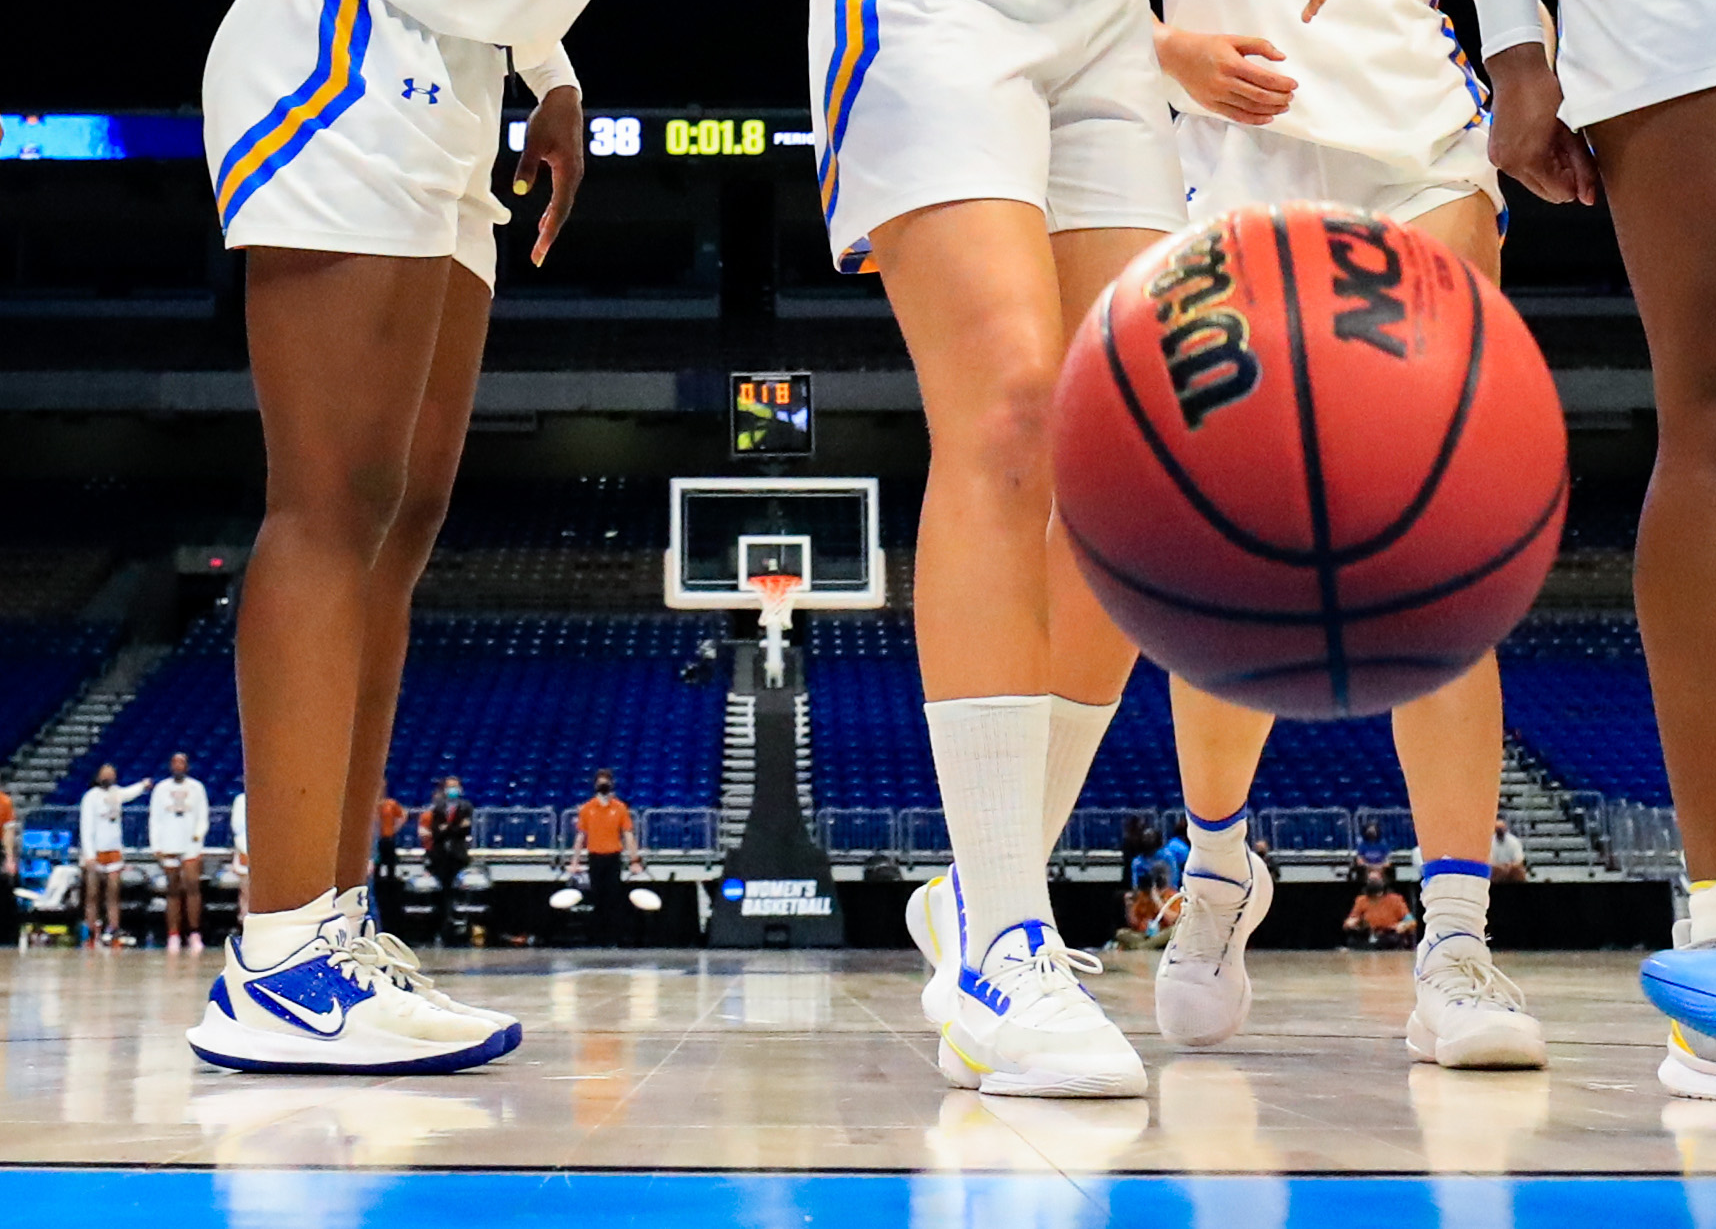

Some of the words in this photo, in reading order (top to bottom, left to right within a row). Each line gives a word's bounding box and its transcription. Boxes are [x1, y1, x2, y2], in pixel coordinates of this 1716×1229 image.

[589, 117, 642, 157] 38
[666, 119, 766, 156] 0:01.8
[773, 131, 816, 146] PERIO
[741, 897, 833, 917] BASKETBALL
